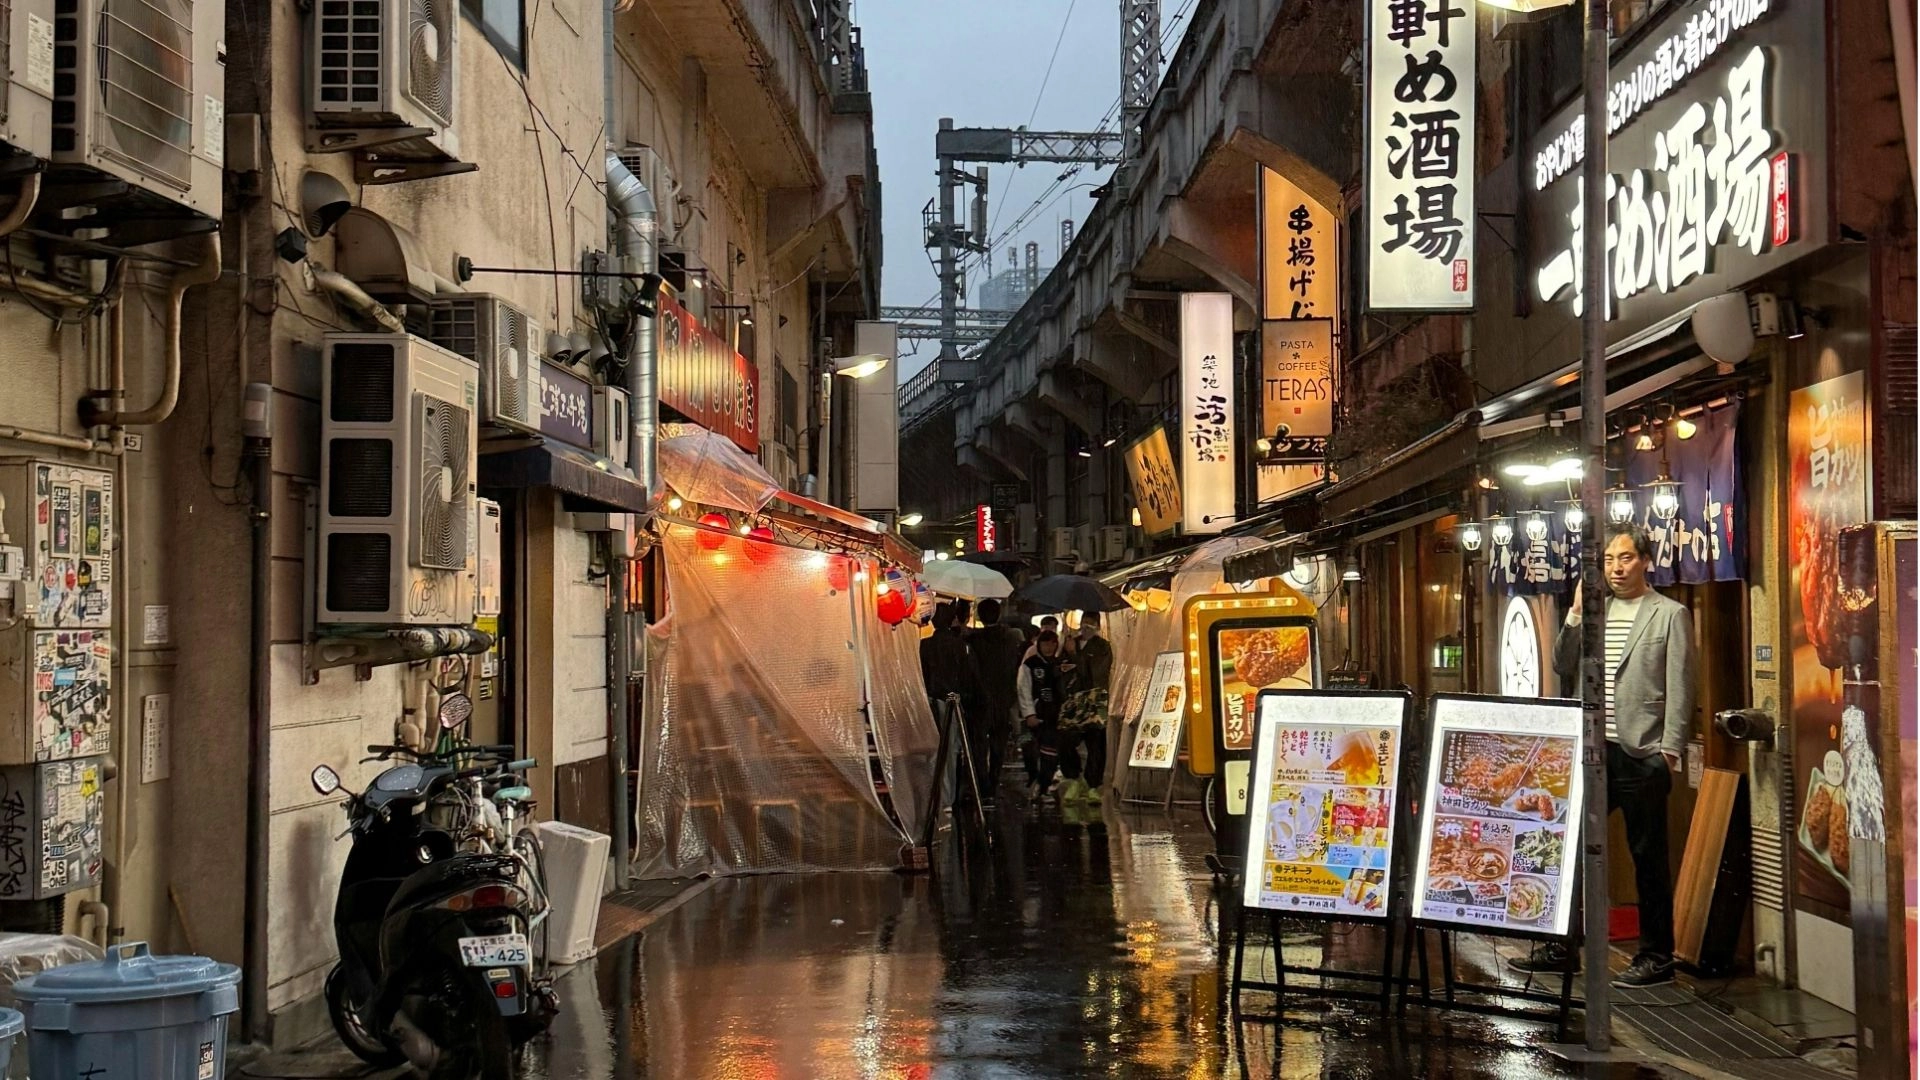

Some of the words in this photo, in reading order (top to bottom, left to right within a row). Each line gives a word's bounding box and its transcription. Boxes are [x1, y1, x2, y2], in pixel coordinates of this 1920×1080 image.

[1281, 340, 1314, 349] PASTA
[1278, 362, 1317, 371] COFFEE
[1266, 378, 1328, 400] TERAS
[1227, 692, 1245, 743] 旨カツ
[1376, 743, 1389, 785] 生ビール
[1284, 865, 1312, 875] テキーラ
